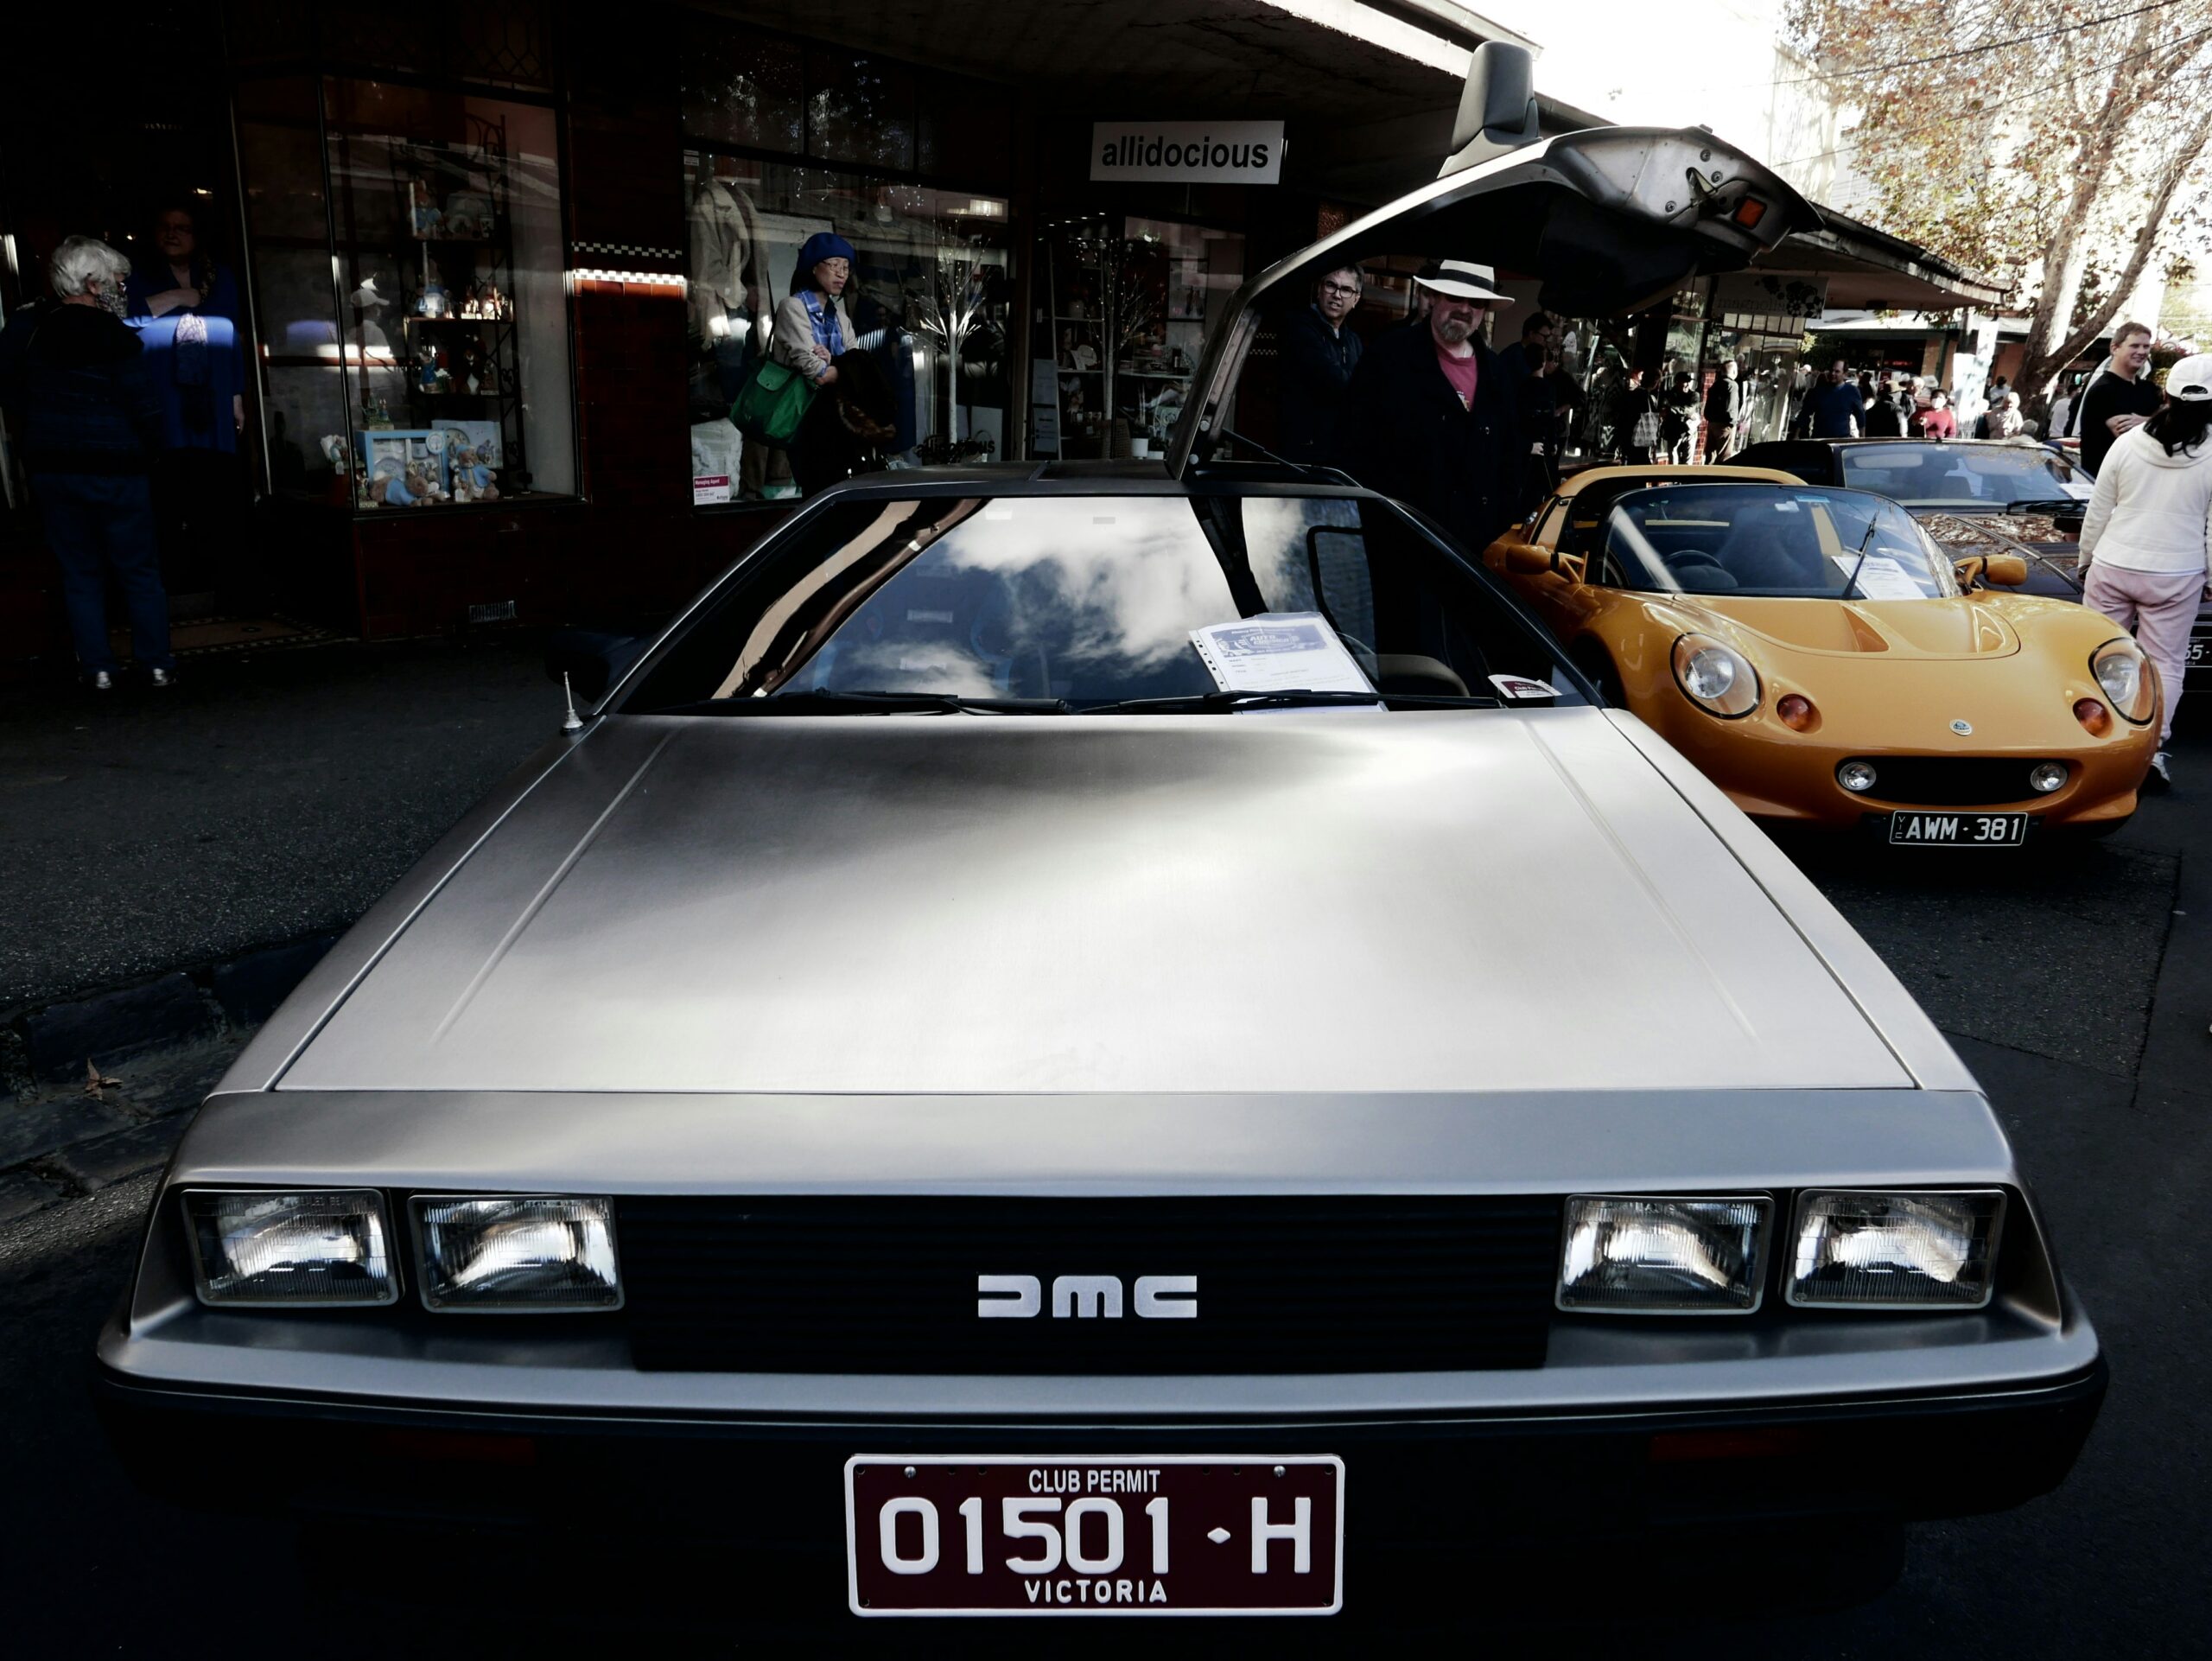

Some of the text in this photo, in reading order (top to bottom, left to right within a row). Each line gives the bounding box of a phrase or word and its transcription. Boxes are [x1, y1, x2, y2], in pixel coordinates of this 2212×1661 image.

[1102, 135, 1269, 169] allidocious
[1905, 817, 2020, 841] AWM 381
[1028, 1469, 1160, 1493] CLUB PERMIT
[879, 1496, 1312, 1575] 01501 H
[1024, 1579, 1167, 1604] VICTORIA
